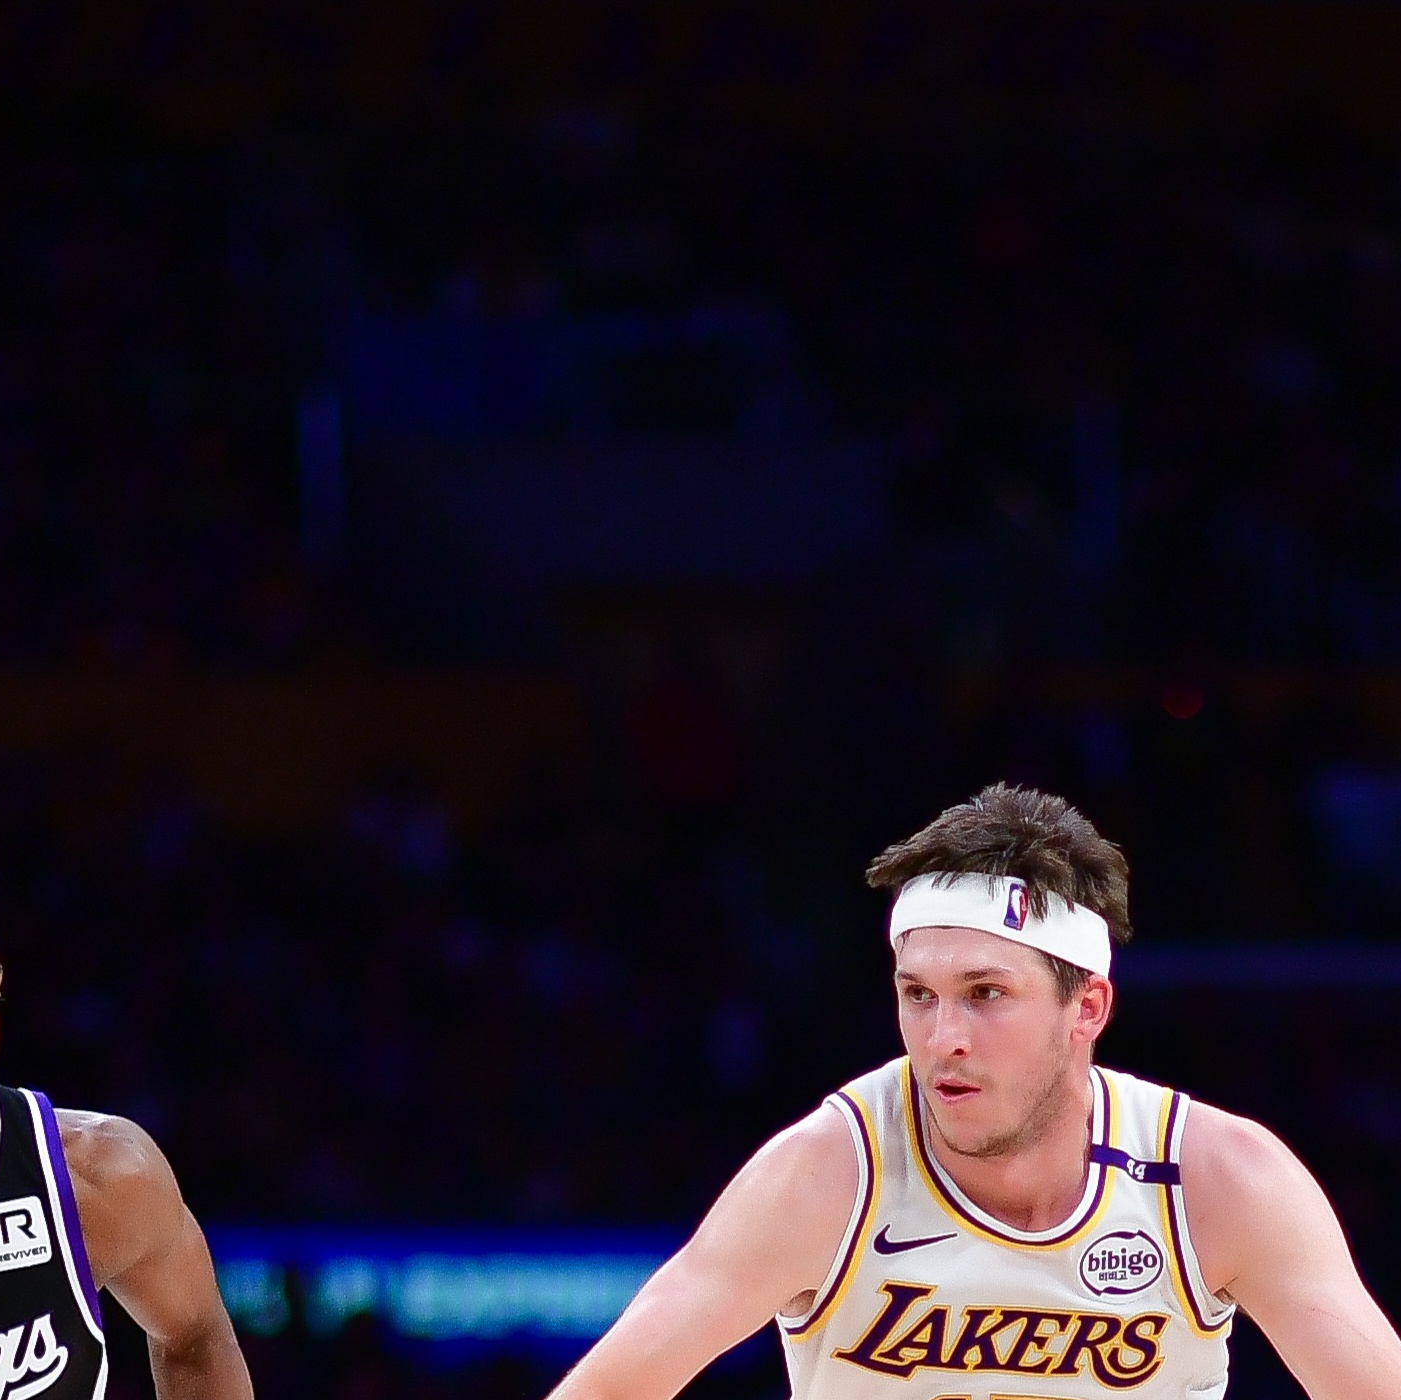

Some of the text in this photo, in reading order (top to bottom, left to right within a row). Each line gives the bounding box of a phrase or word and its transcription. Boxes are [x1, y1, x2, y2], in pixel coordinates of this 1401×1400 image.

[1088, 1248, 1158, 1275] bibigo
[1098, 1270, 1128, 1282] 비비고
[833, 1279, 1171, 1389] LAKERS
